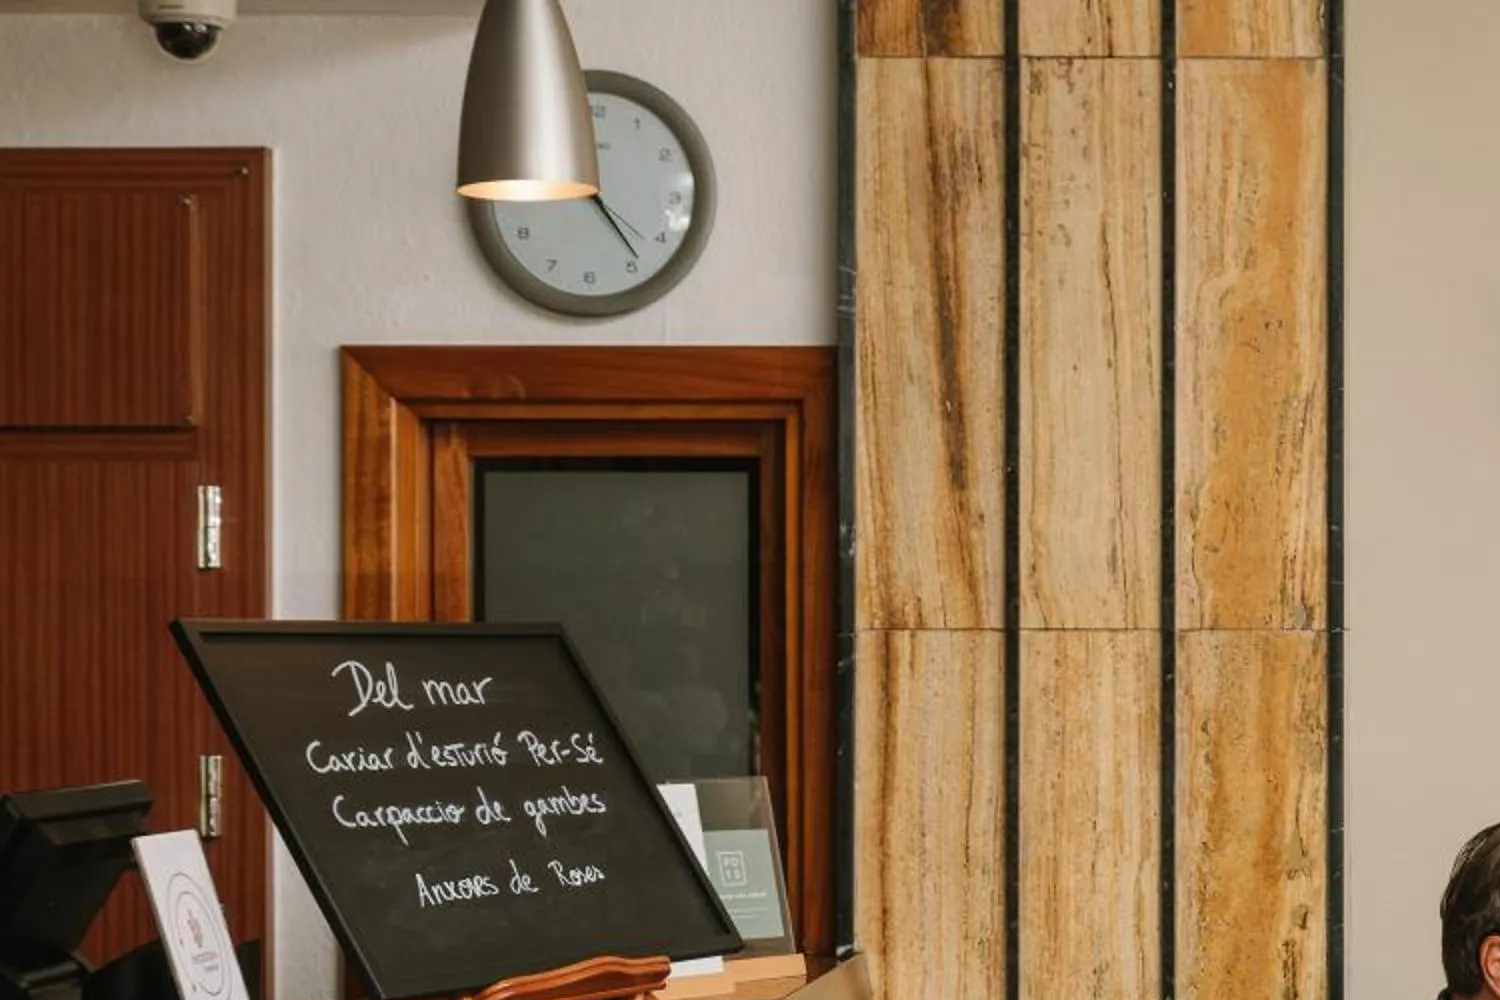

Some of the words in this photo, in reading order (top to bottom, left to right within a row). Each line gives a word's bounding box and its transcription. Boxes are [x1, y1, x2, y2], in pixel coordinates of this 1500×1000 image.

[654, 231, 667, 244] 4
[546, 258, 558, 272] 7
[625, 260, 639, 274] 5
[331, 659, 415, 717] Del
[421, 676, 494, 705] mar
[305, 740, 394, 774] Caviar
[332, 794, 466, 846] Carpaccio
[475, 786, 512, 825] de
[523, 785, 607, 838] gambes
[508, 858, 540, 895] de
[547, 859, 606, 887] Roses
